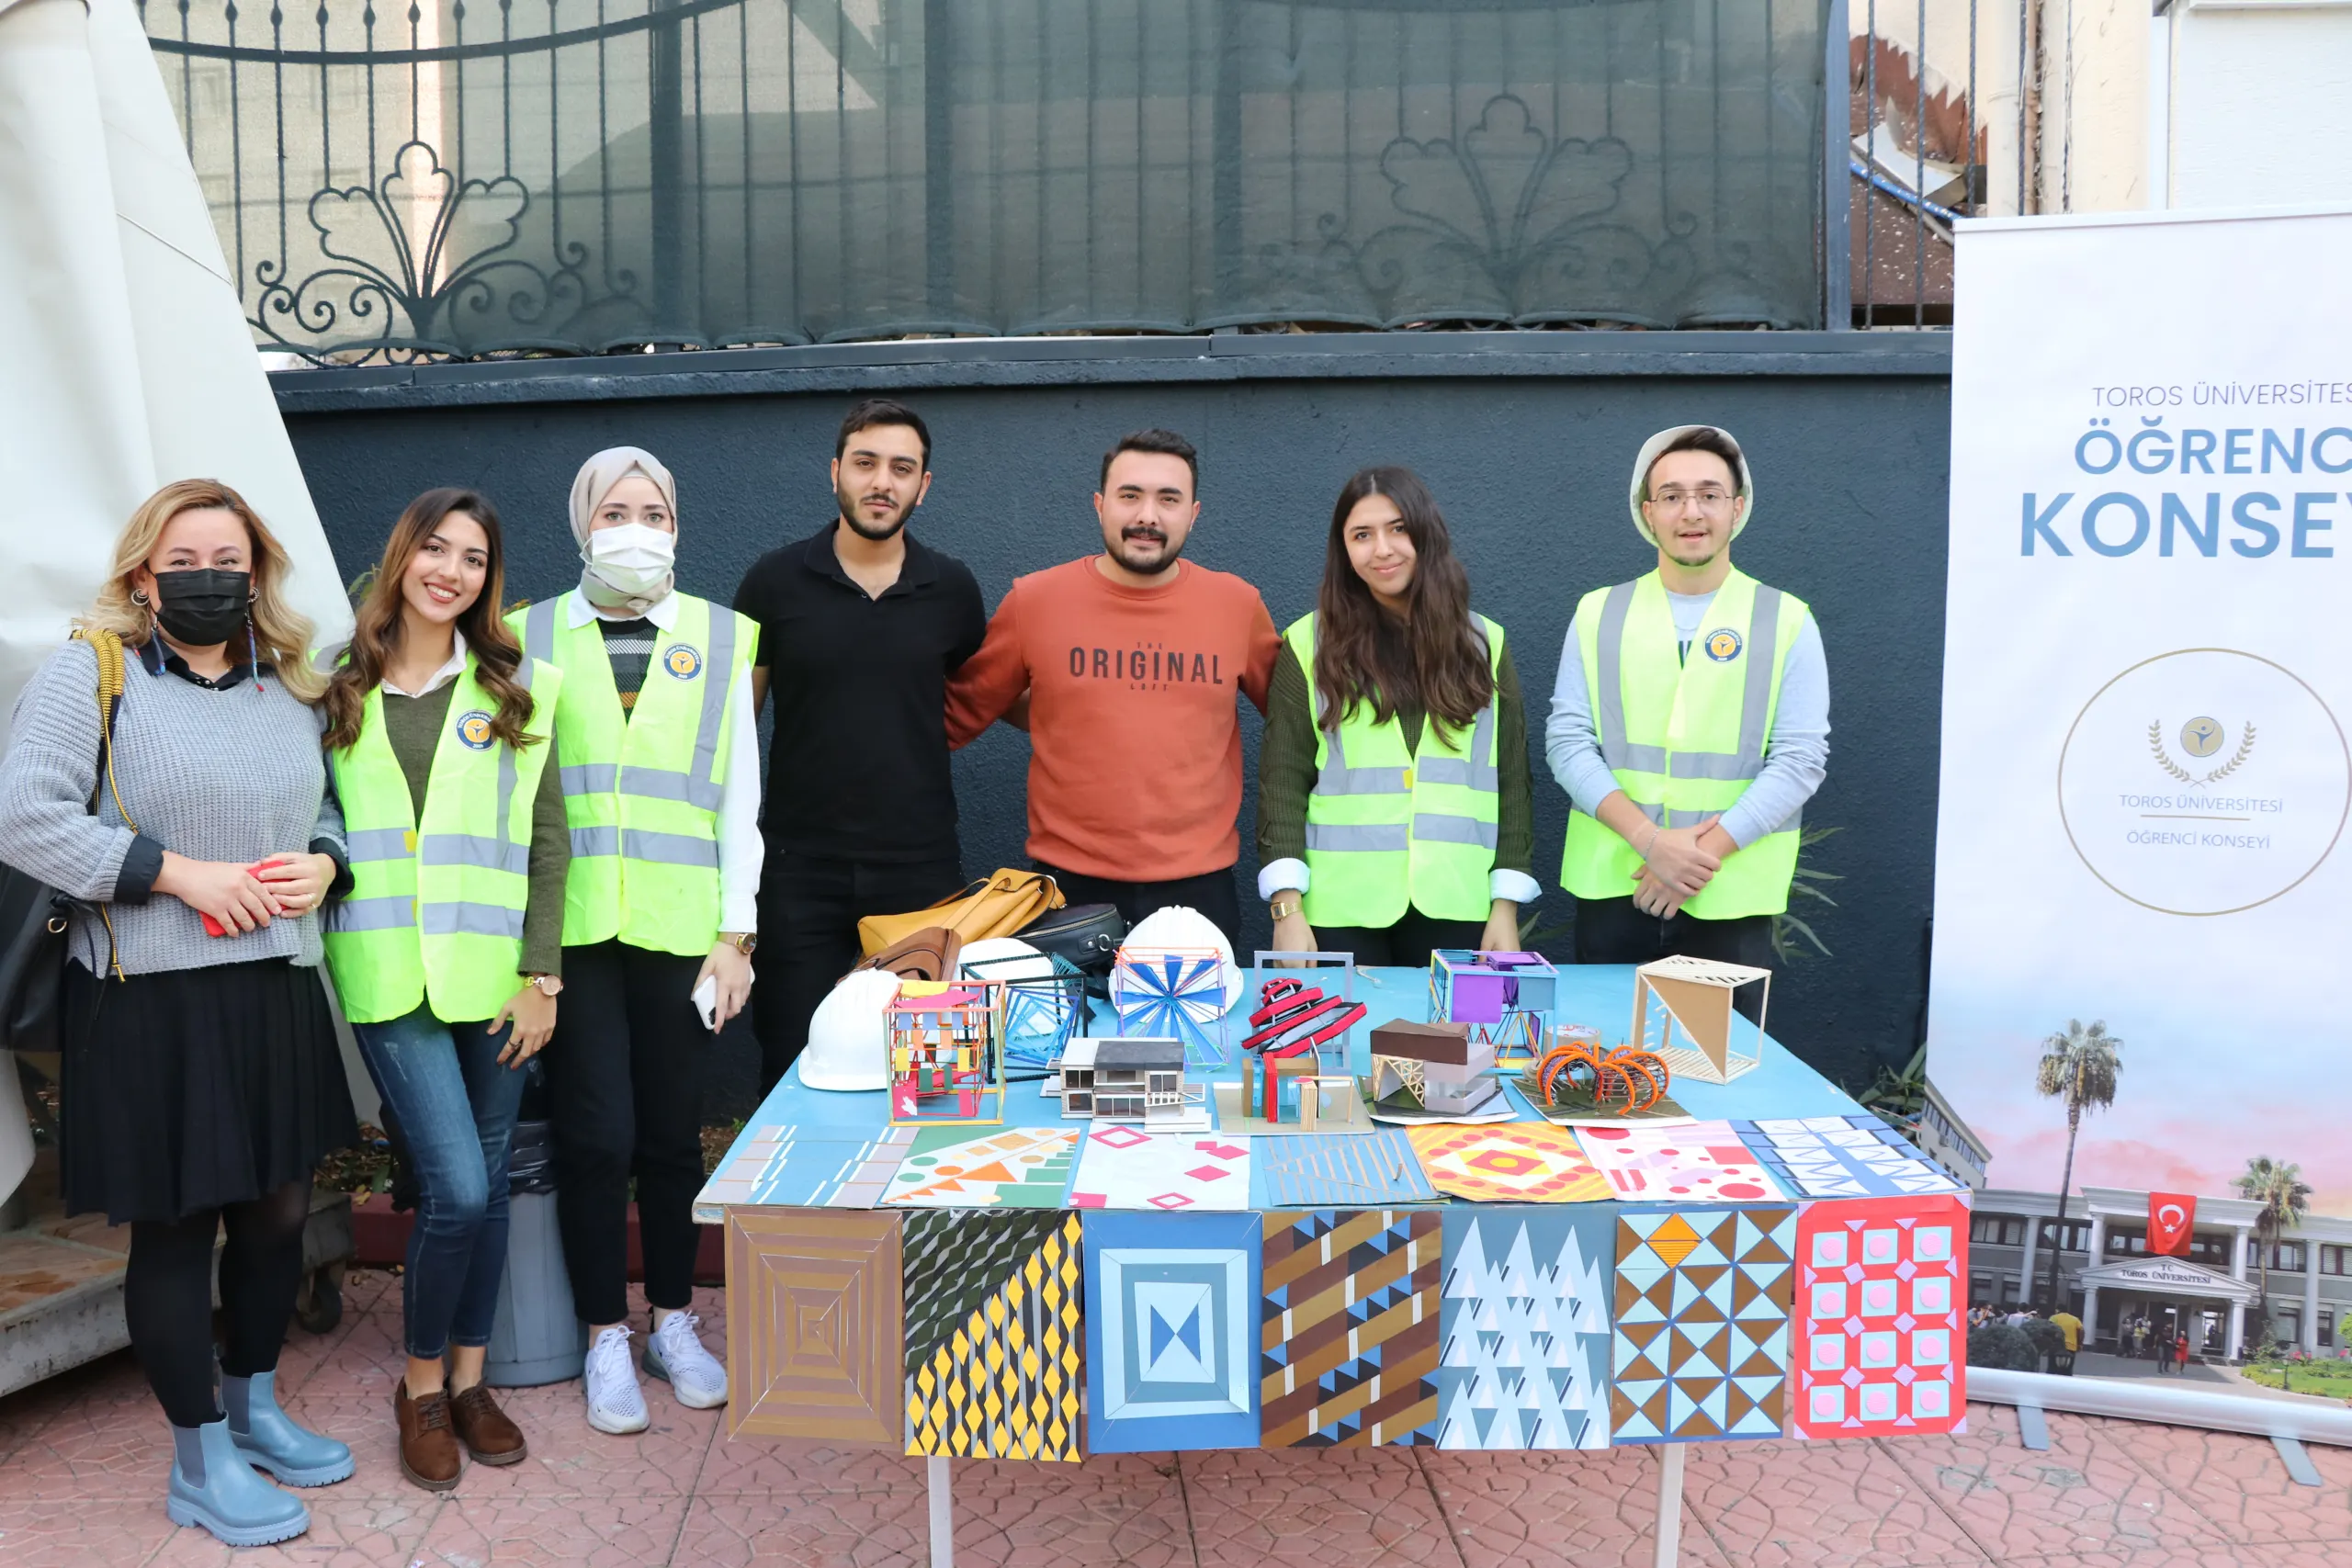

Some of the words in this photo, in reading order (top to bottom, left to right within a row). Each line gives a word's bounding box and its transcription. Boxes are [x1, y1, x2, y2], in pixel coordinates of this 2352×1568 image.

[2092, 386, 2183, 406] TOROS
[2020, 491, 2352, 558] KONSE
[1069, 647, 1223, 684] ORIGINAL
[2119, 795, 2172, 808] TOROS
[2177, 795, 2283, 813] ÜNİVERSİTESİ
[2127, 829, 2197, 845] ÖĞRENCİ
[2201, 833, 2270, 849] KONSEYİ
[2121, 1269, 2148, 1279] TOROS
